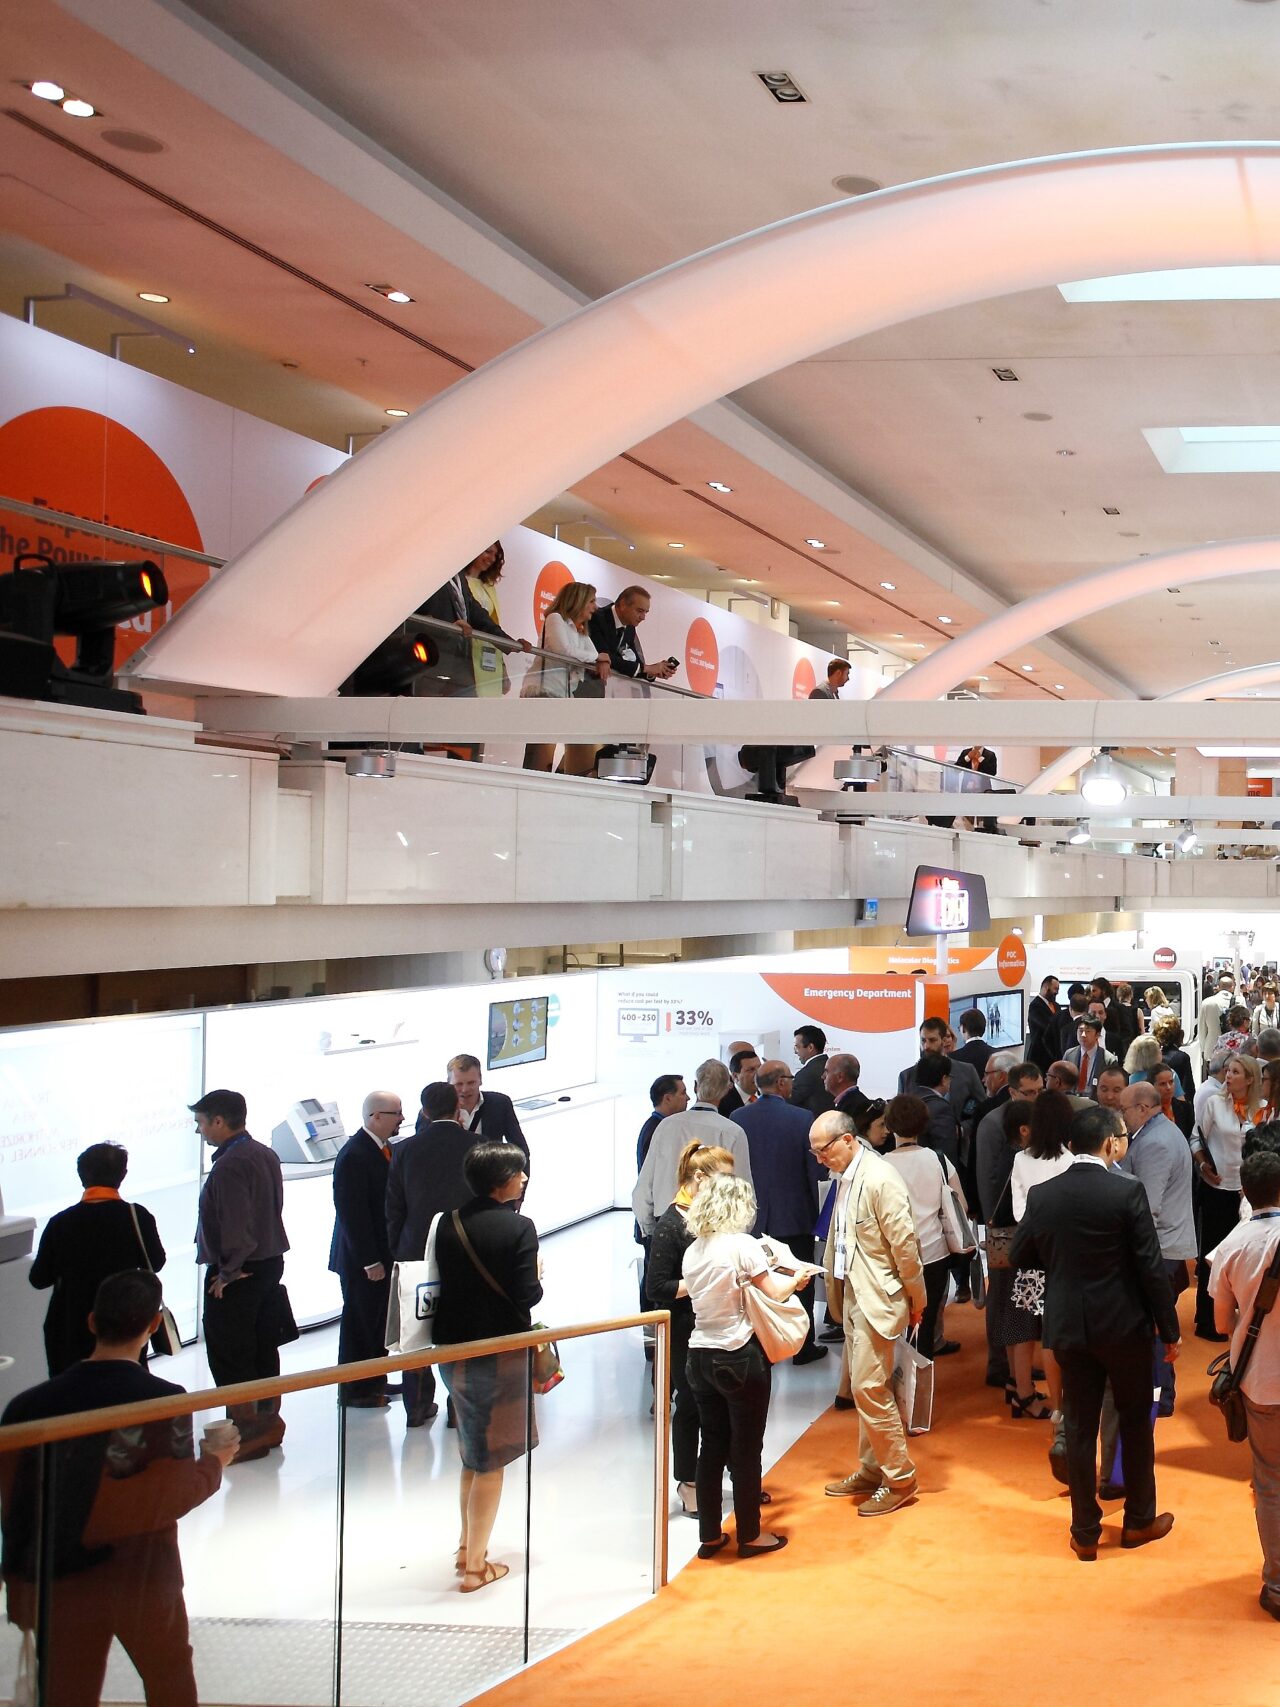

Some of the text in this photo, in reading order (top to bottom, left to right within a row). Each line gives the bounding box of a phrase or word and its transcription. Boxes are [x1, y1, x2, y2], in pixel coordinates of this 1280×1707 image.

[888, 956, 960, 966] Molecular Diagtics
[1154, 954, 1175, 962] New!
[803, 987, 912, 999] Emergency Department
[675, 1010, 714, 1026] 33%
